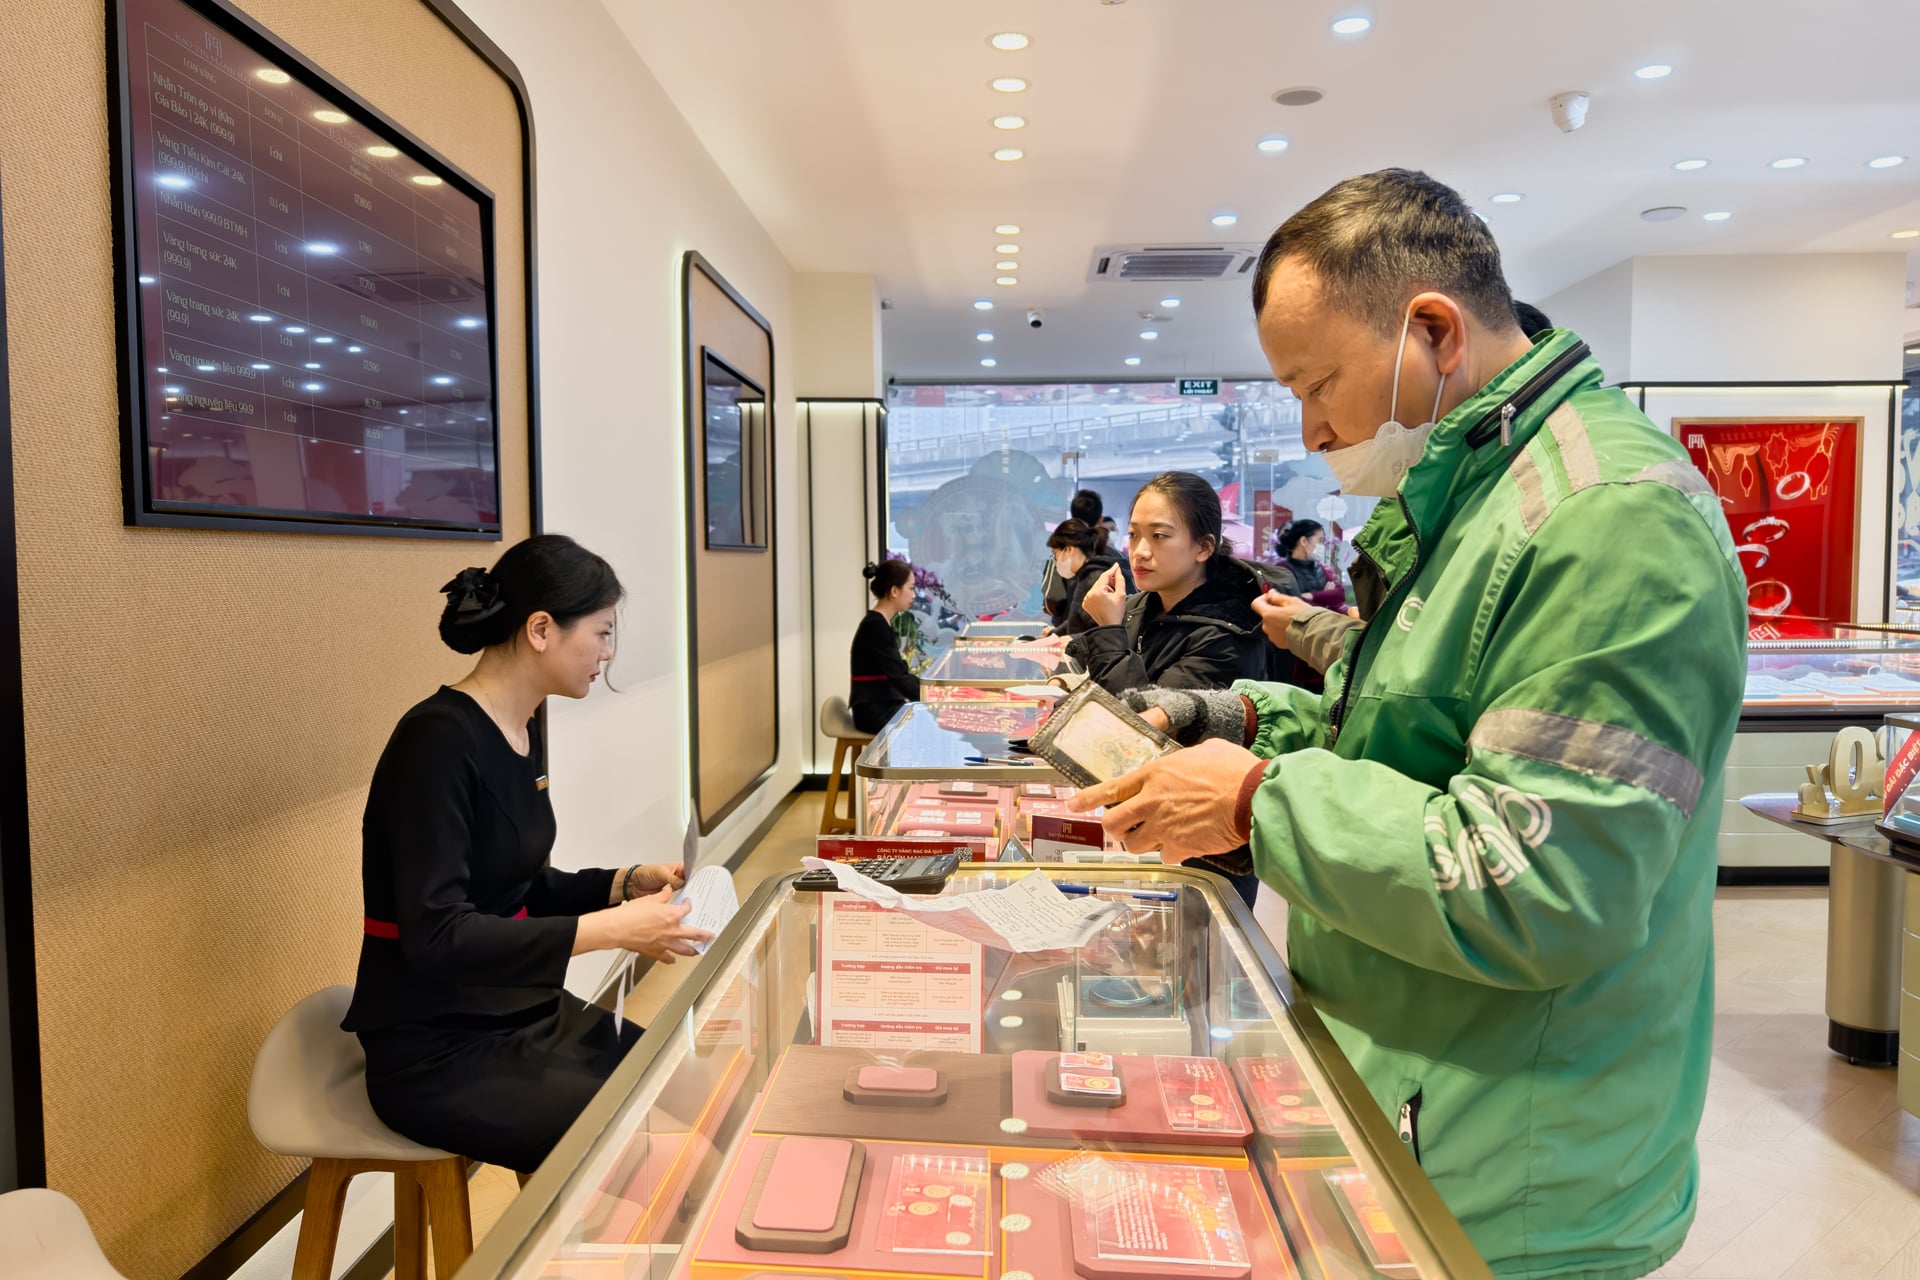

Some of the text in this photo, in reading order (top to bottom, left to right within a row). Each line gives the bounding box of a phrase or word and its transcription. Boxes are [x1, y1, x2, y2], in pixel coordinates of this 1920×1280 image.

[194, 111, 209, 130] 24K
[210, 119, 235, 146] (999.9)
[158, 131, 179, 154] Vàng
[201, 150, 215, 169] Kim
[202, 207, 223, 226] 999.9
[224, 217, 248, 239] BTMH
[163, 229, 238, 271] Vàng trang sức 24K
[164, 250, 192, 273] (999.9)
[166, 288, 240, 324] Vàng trang sức 24K
[167, 308, 190, 329] (99.9)
[169, 347, 191, 367] Vàng
[237, 364, 256, 380] 999.9
[239, 401, 254, 415] 99.9
